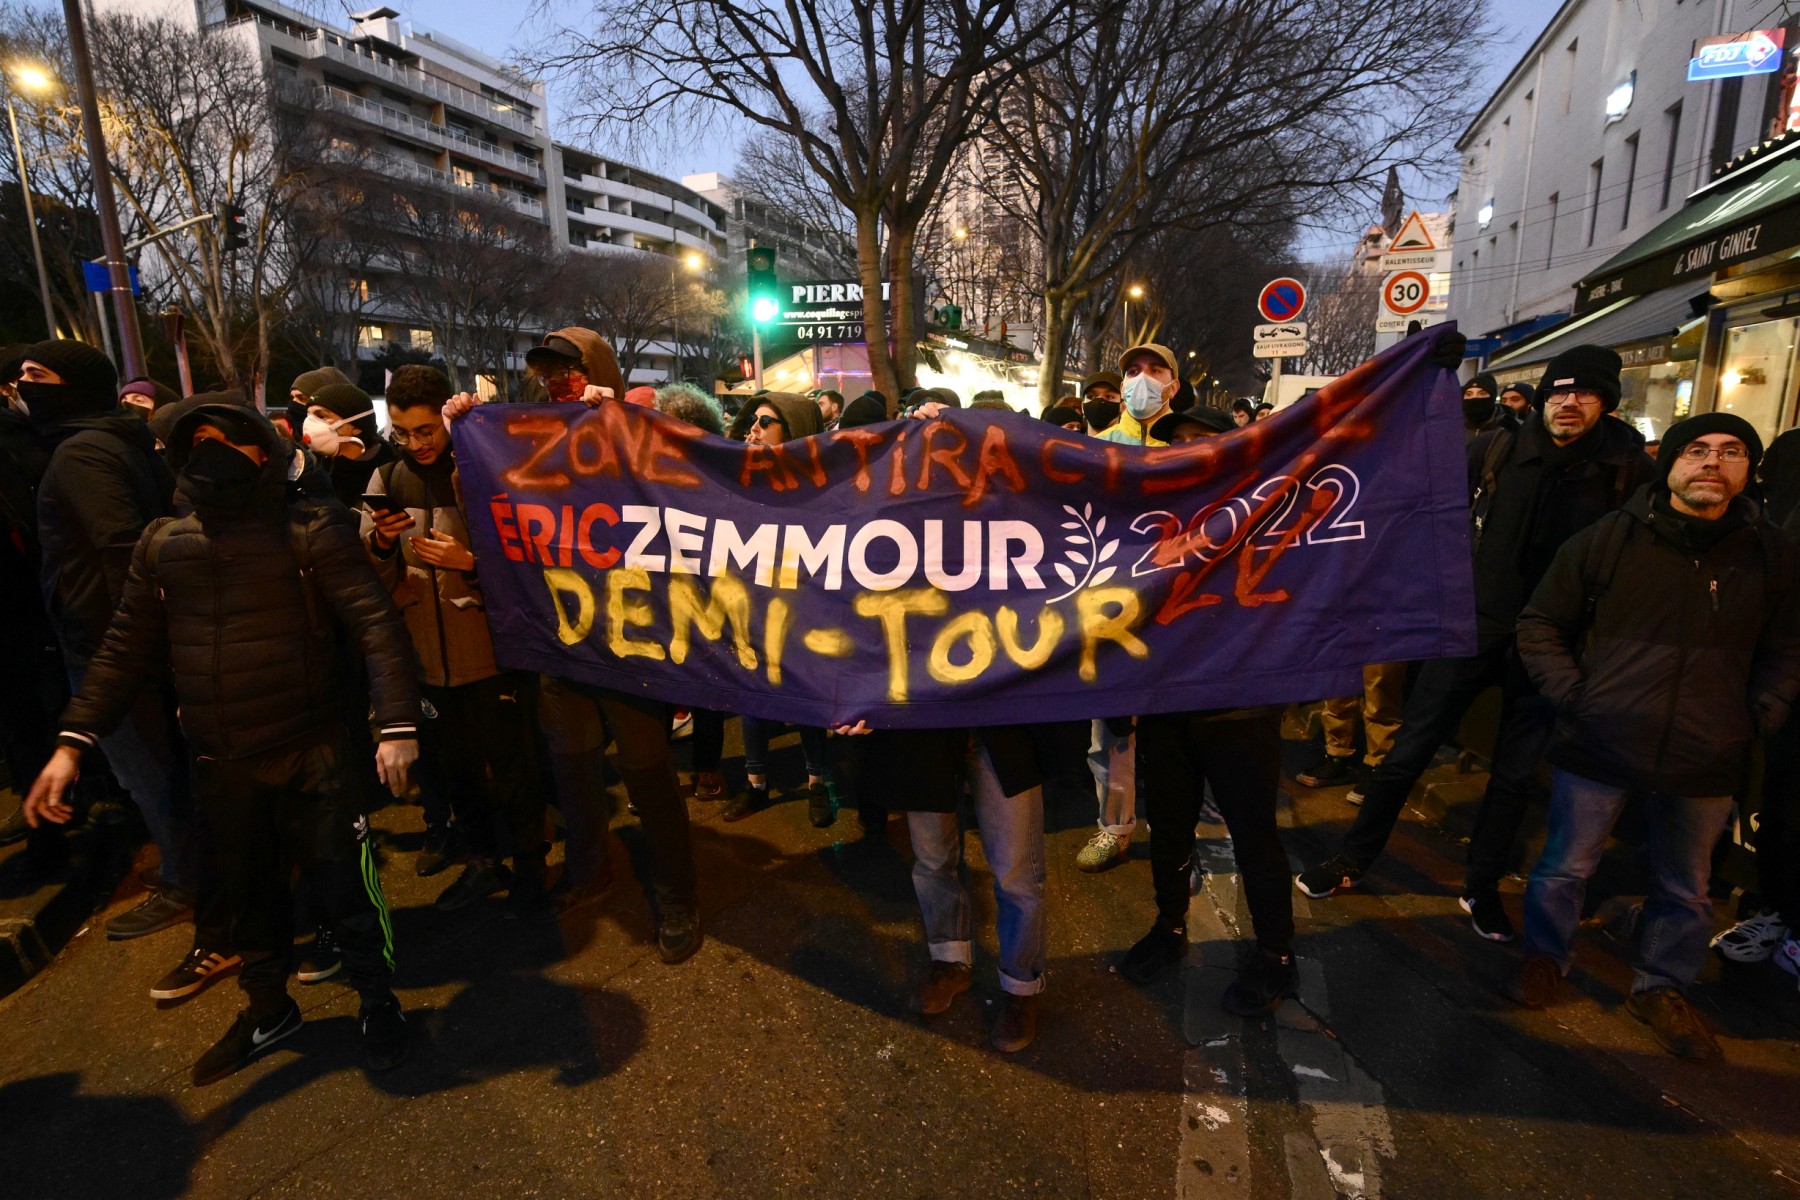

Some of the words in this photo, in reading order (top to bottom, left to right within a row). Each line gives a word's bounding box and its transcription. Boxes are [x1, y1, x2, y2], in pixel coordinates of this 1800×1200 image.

[1685, 241, 1717, 272] SAINT
[1720, 224, 1762, 260] GINIEZ
[1385, 257, 1435, 265] RALENTISSEUR
[792, 282, 891, 304] PIERRT
[1393, 283, 1420, 302] 30
[797, 326, 814, 339] 04
[817, 325, 833, 339] 91
[1379, 320, 1405, 328] CONTRE
[502, 398, 702, 490] ZONE
[1129, 463, 1366, 578] 2022
